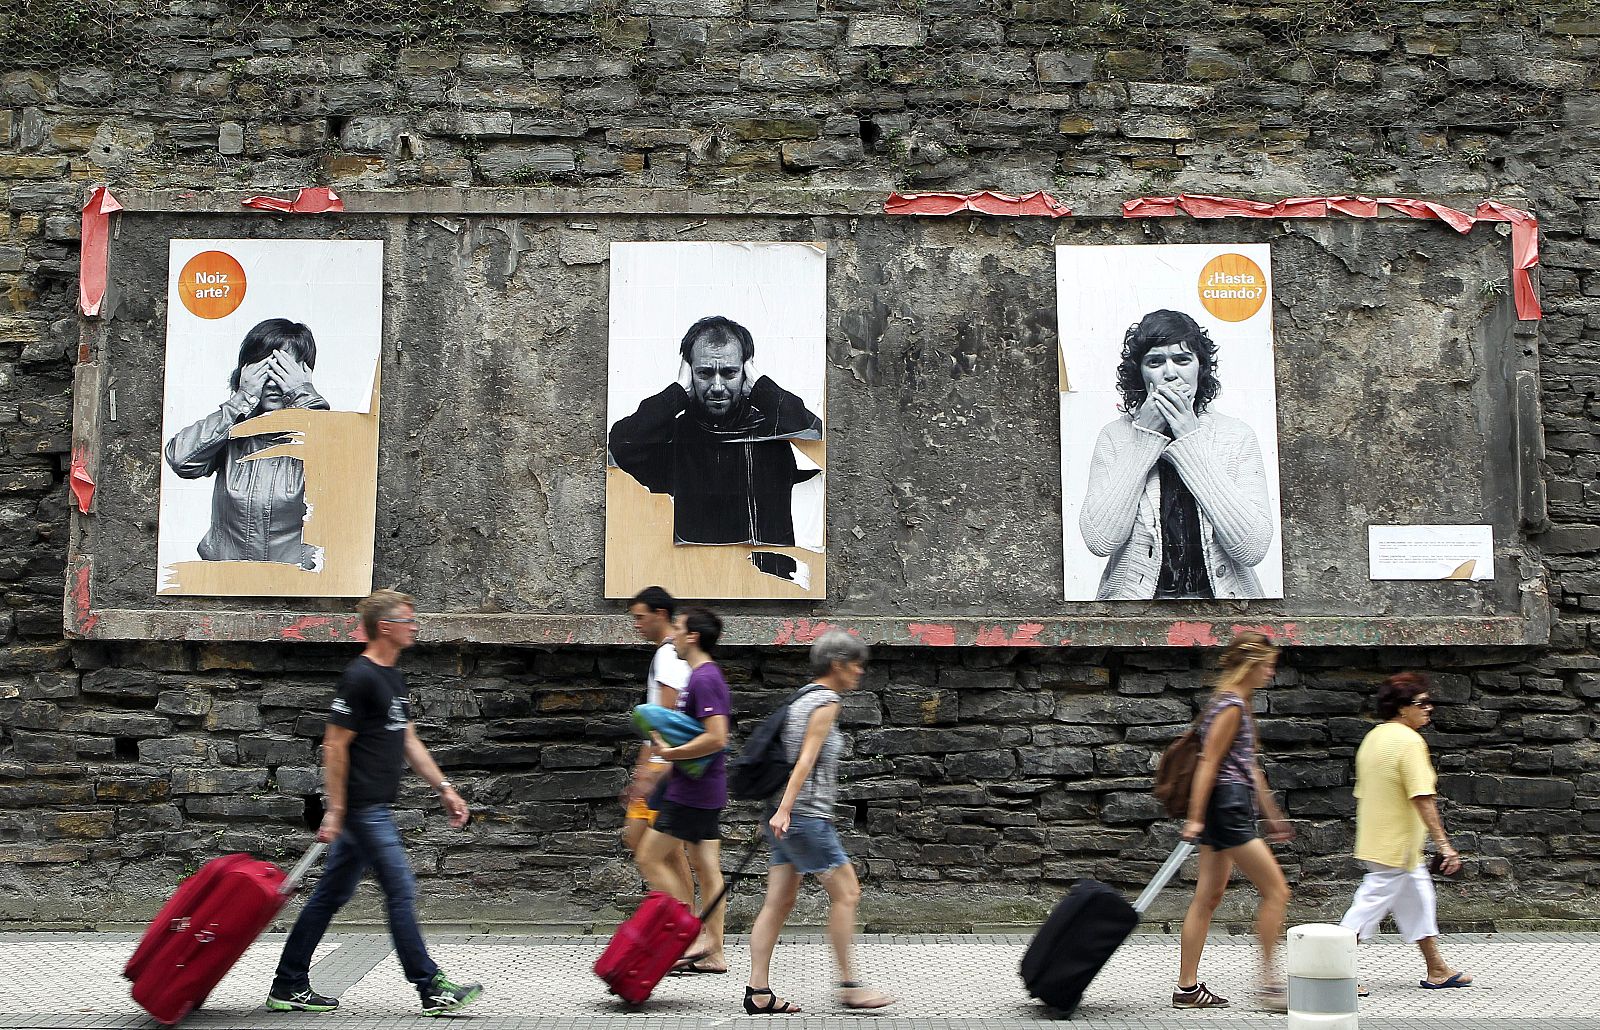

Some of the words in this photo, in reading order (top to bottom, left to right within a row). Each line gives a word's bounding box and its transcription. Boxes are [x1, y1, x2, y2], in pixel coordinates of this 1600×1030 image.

[195, 272, 227, 284] Noiz
[1207, 271, 1255, 287] ¿Hasta
[195, 285, 230, 299] arte?
[1203, 287, 1263, 299] cuando?
